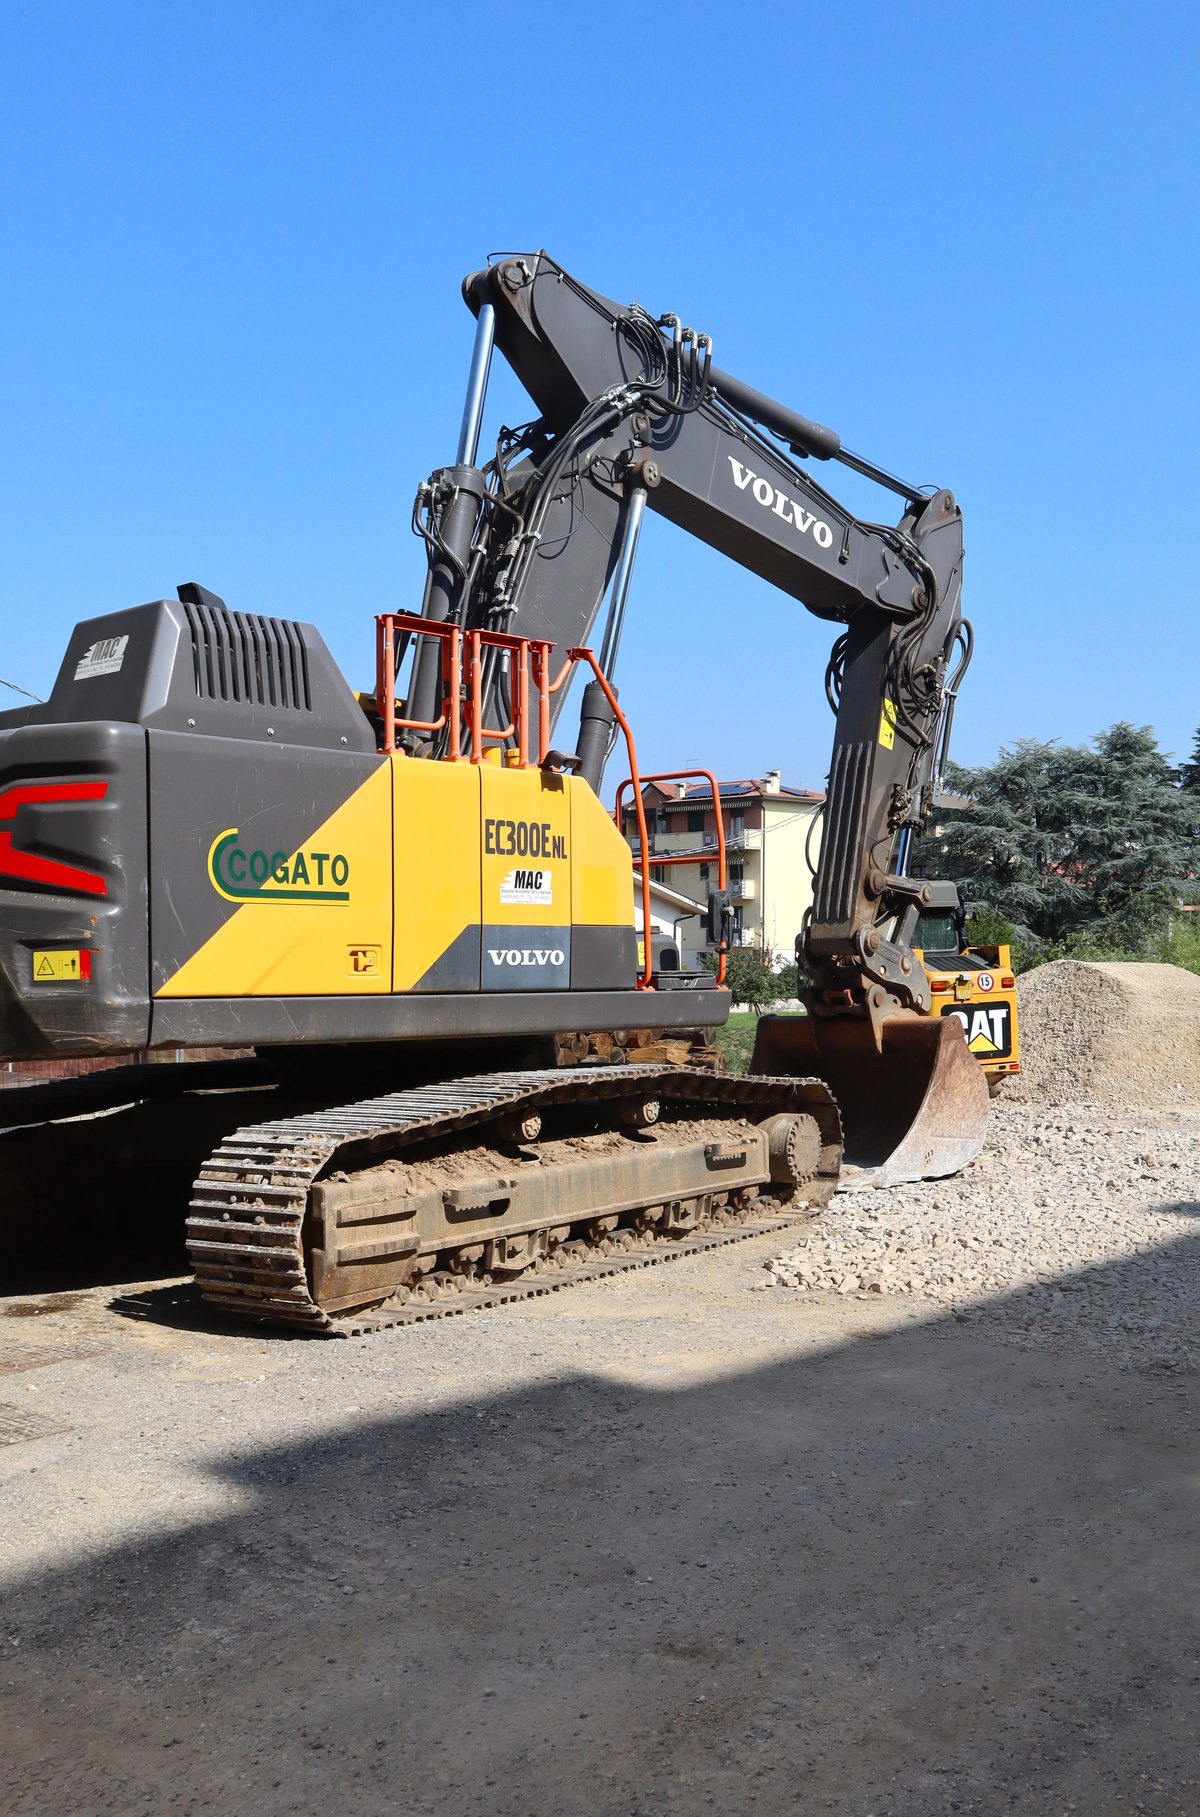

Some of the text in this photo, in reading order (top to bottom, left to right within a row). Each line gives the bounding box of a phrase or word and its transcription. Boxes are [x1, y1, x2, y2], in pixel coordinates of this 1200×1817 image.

[728, 455, 833, 548] VOLVO
[90, 637, 121, 662] MAC
[228, 848, 349, 886] COGATO
[514, 870, 543, 890] MAC
[488, 949, 565, 966] VOLVO
[980, 976, 990, 987] 15
